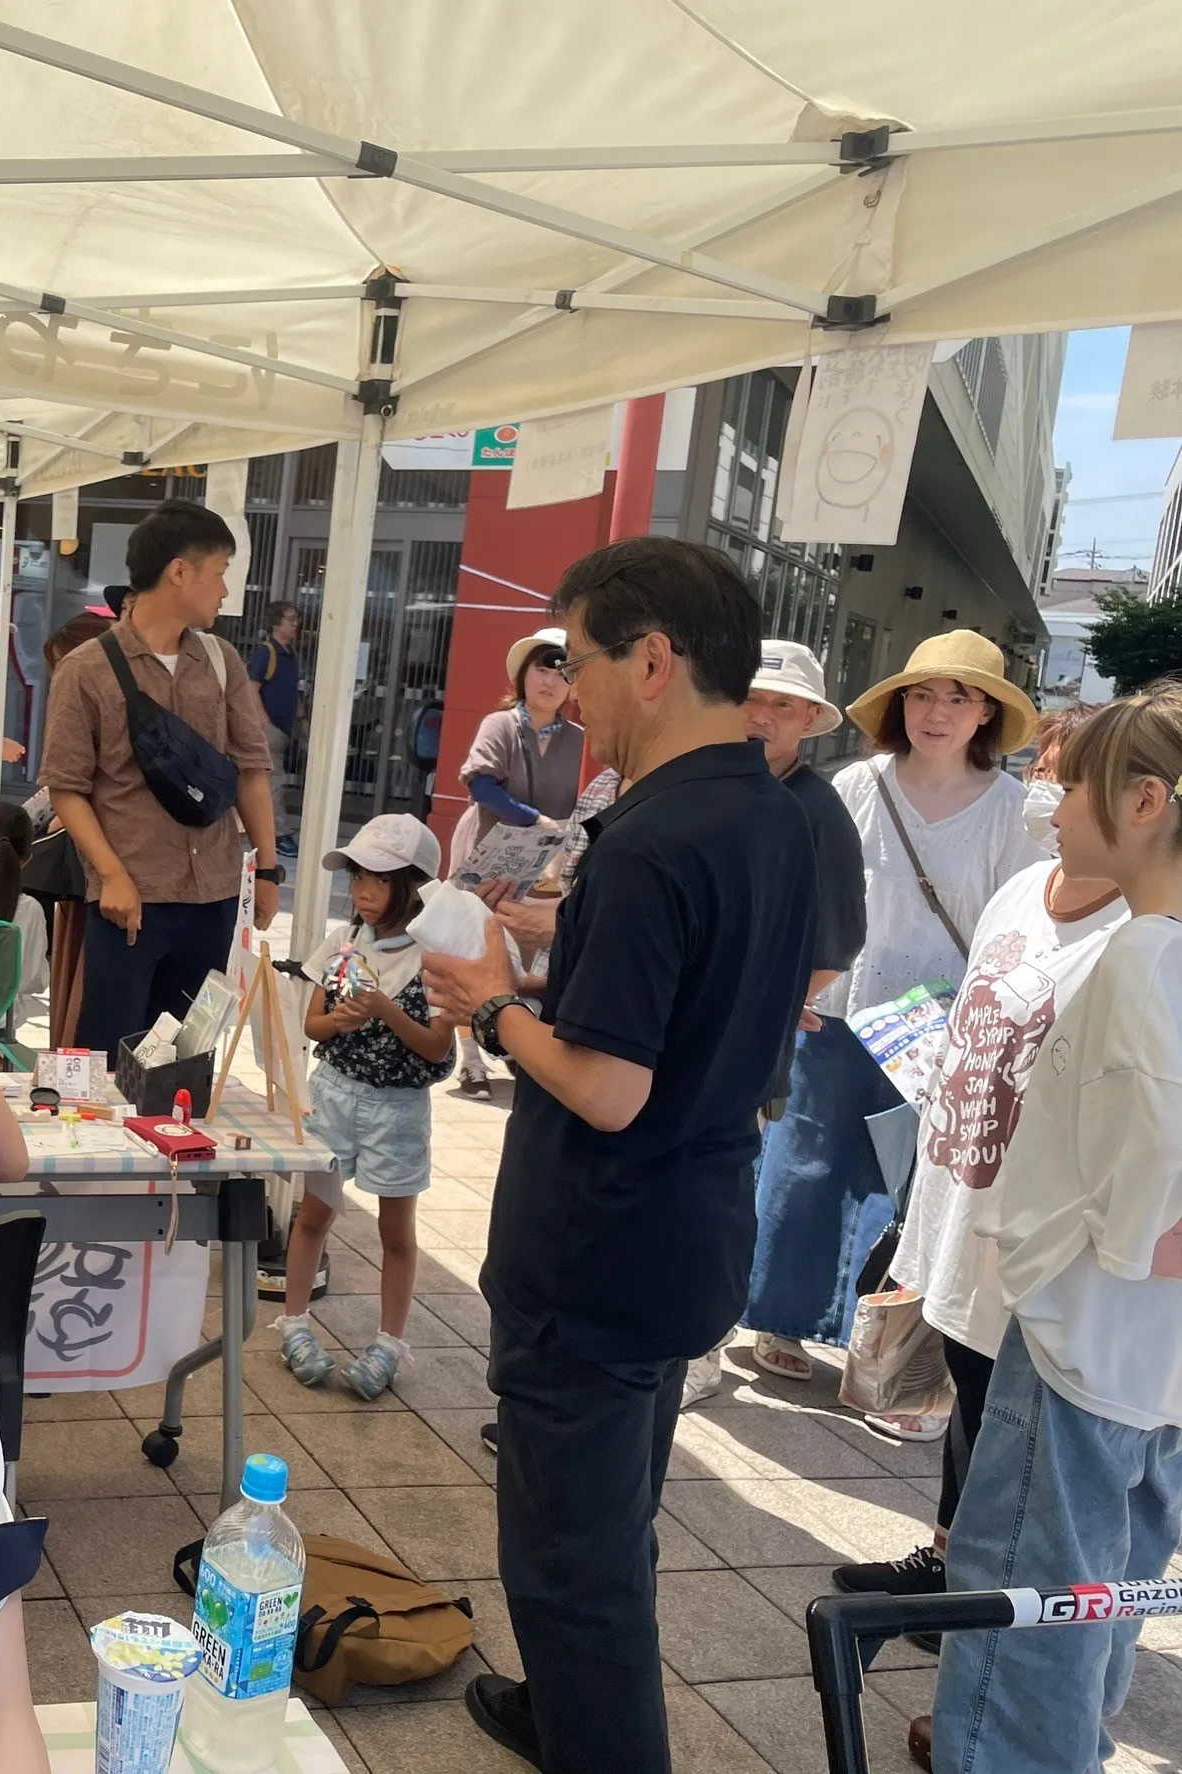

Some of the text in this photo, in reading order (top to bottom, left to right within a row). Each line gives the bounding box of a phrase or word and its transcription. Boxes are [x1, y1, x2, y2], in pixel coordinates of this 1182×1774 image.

[968, 1004, 1000, 1030] MAPLE
[259, 1596, 282, 1611] GREEN
[1042, 1592, 1112, 1622] GR
[1119, 1588, 1182, 1602] GAZO
[192, 1620, 227, 1667] GREEN
